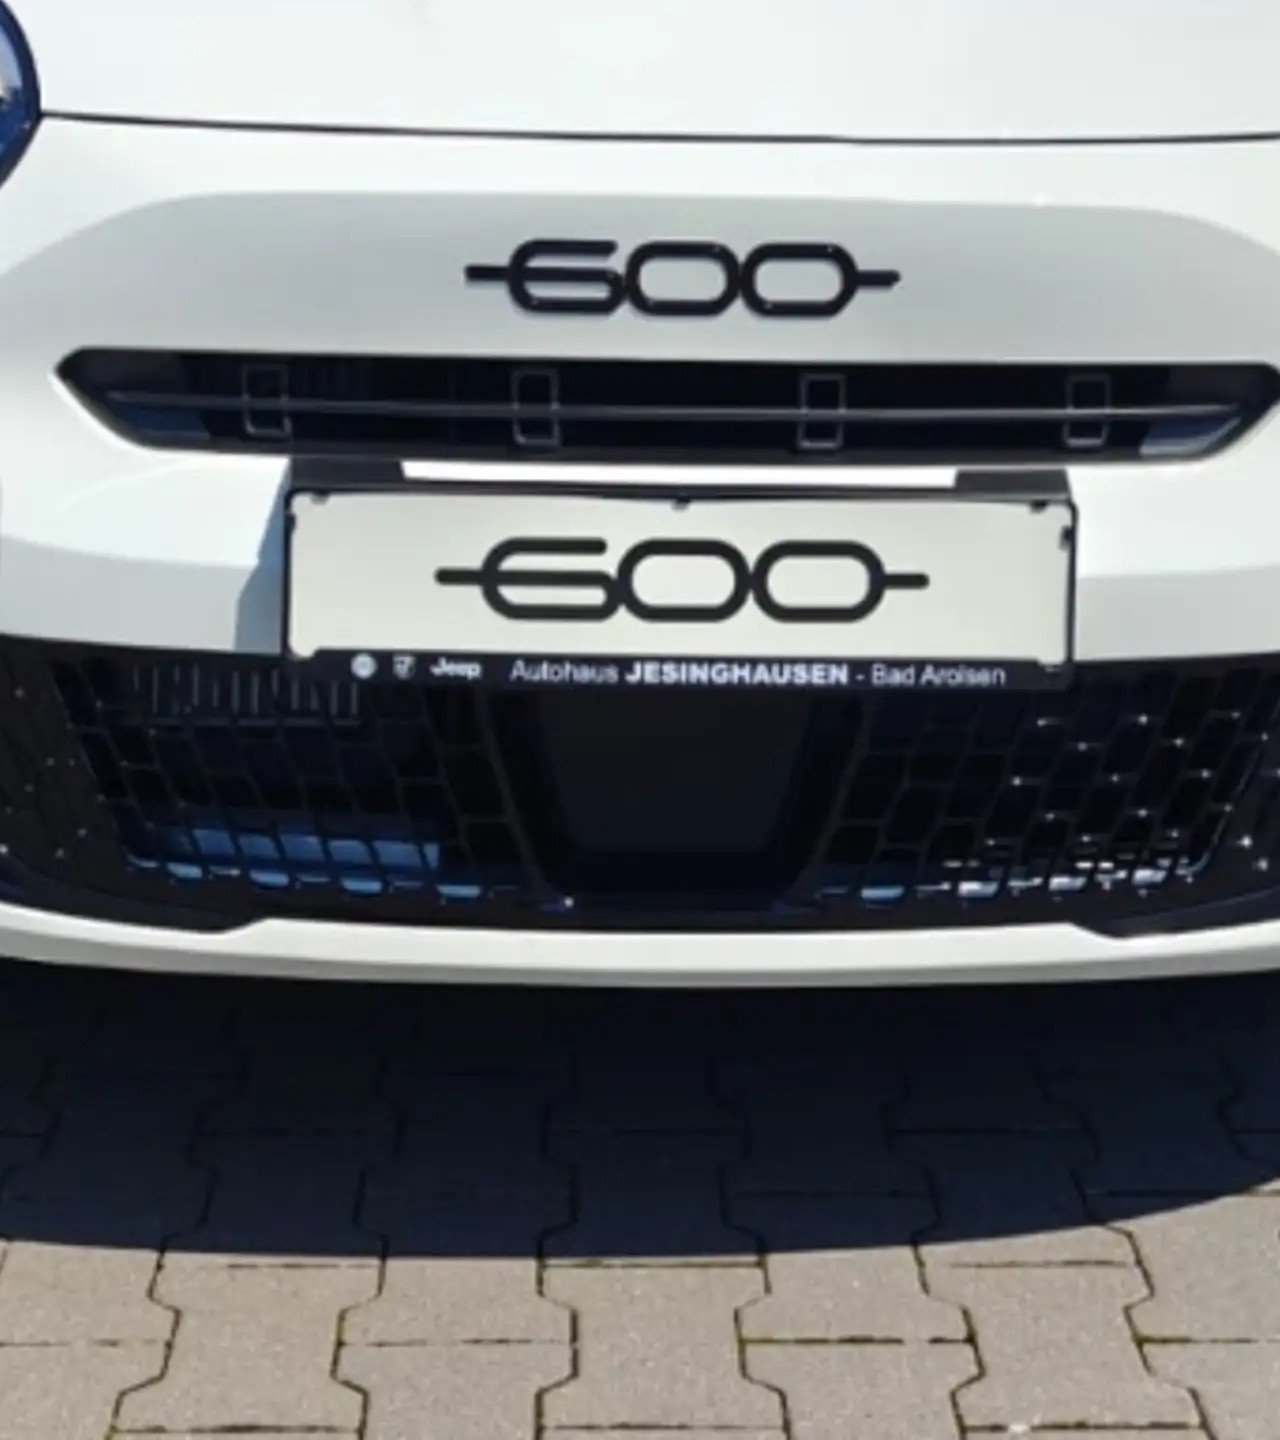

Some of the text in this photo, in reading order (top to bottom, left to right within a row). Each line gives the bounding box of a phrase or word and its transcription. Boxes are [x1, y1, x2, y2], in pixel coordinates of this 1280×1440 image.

[508, 239, 860, 318] 600
[480, 536, 885, 623] 600
[510, 659, 619, 683] Autohaus
[625, 662, 849, 686] JESINGHAUSEN
[872, 663, 916, 686] Bad
[920, 664, 1006, 687] Arolsen
